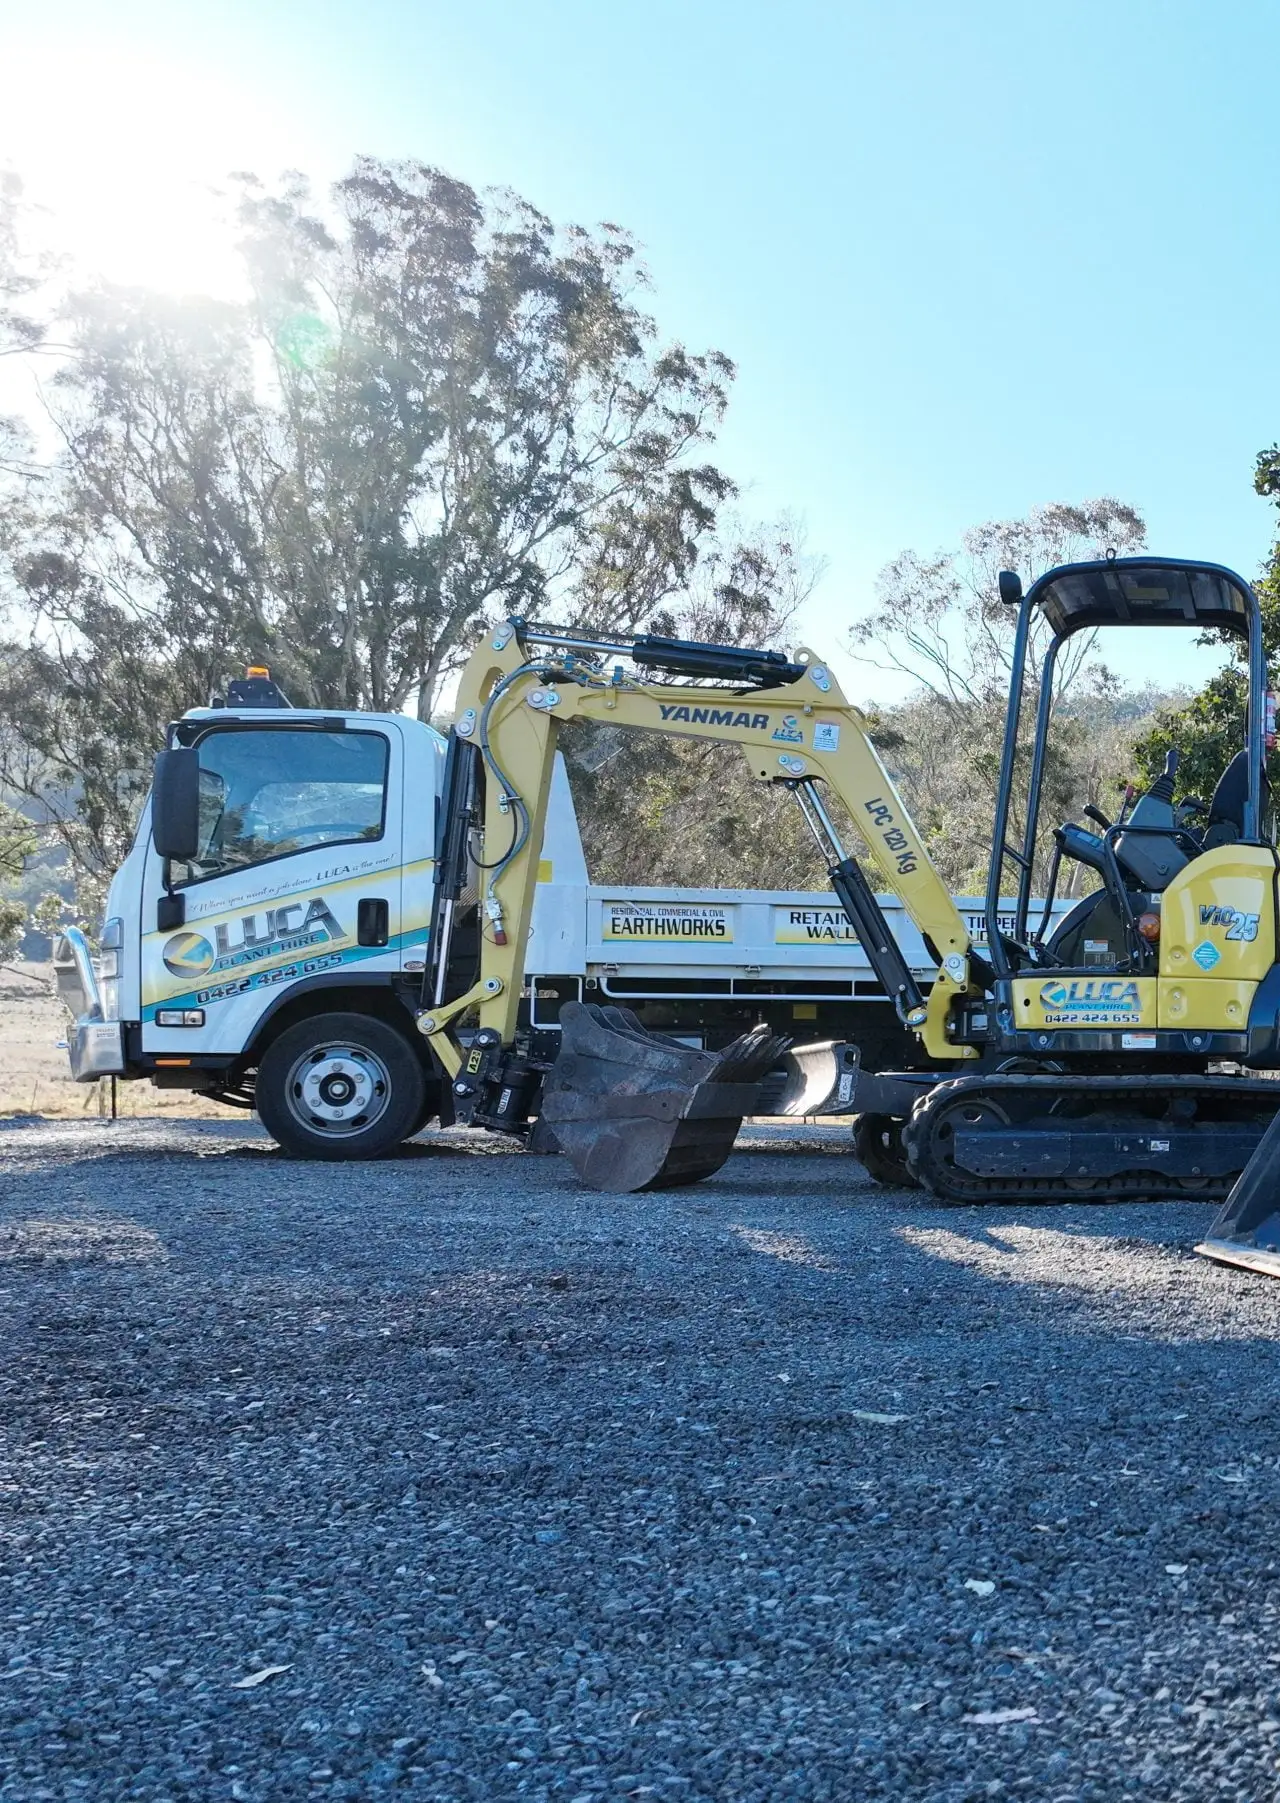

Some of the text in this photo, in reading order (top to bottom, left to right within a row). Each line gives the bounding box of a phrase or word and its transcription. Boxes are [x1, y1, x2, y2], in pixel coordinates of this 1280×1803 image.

[659, 704, 770, 730] YANMAR
[864, 797, 893, 826] LPC
[883, 827, 908, 851] 120
[316, 865, 350, 881] LUCA
[658, 907, 701, 917] COMMERCIAL
[709, 909, 725, 918] CIVIL
[790, 911, 853, 926] RETAIN
[214, 897, 348, 957] LUCA
[611, 916, 726, 937] EARTHWORKS
[806, 926, 860, 939] WALL
[219, 933, 321, 970] PLANT HIRE
[197, 954, 343, 1004] 0422 424 655
[1068, 982, 1143, 1012] LUCA
[1045, 1014, 1140, 1023] 0422 424 655
